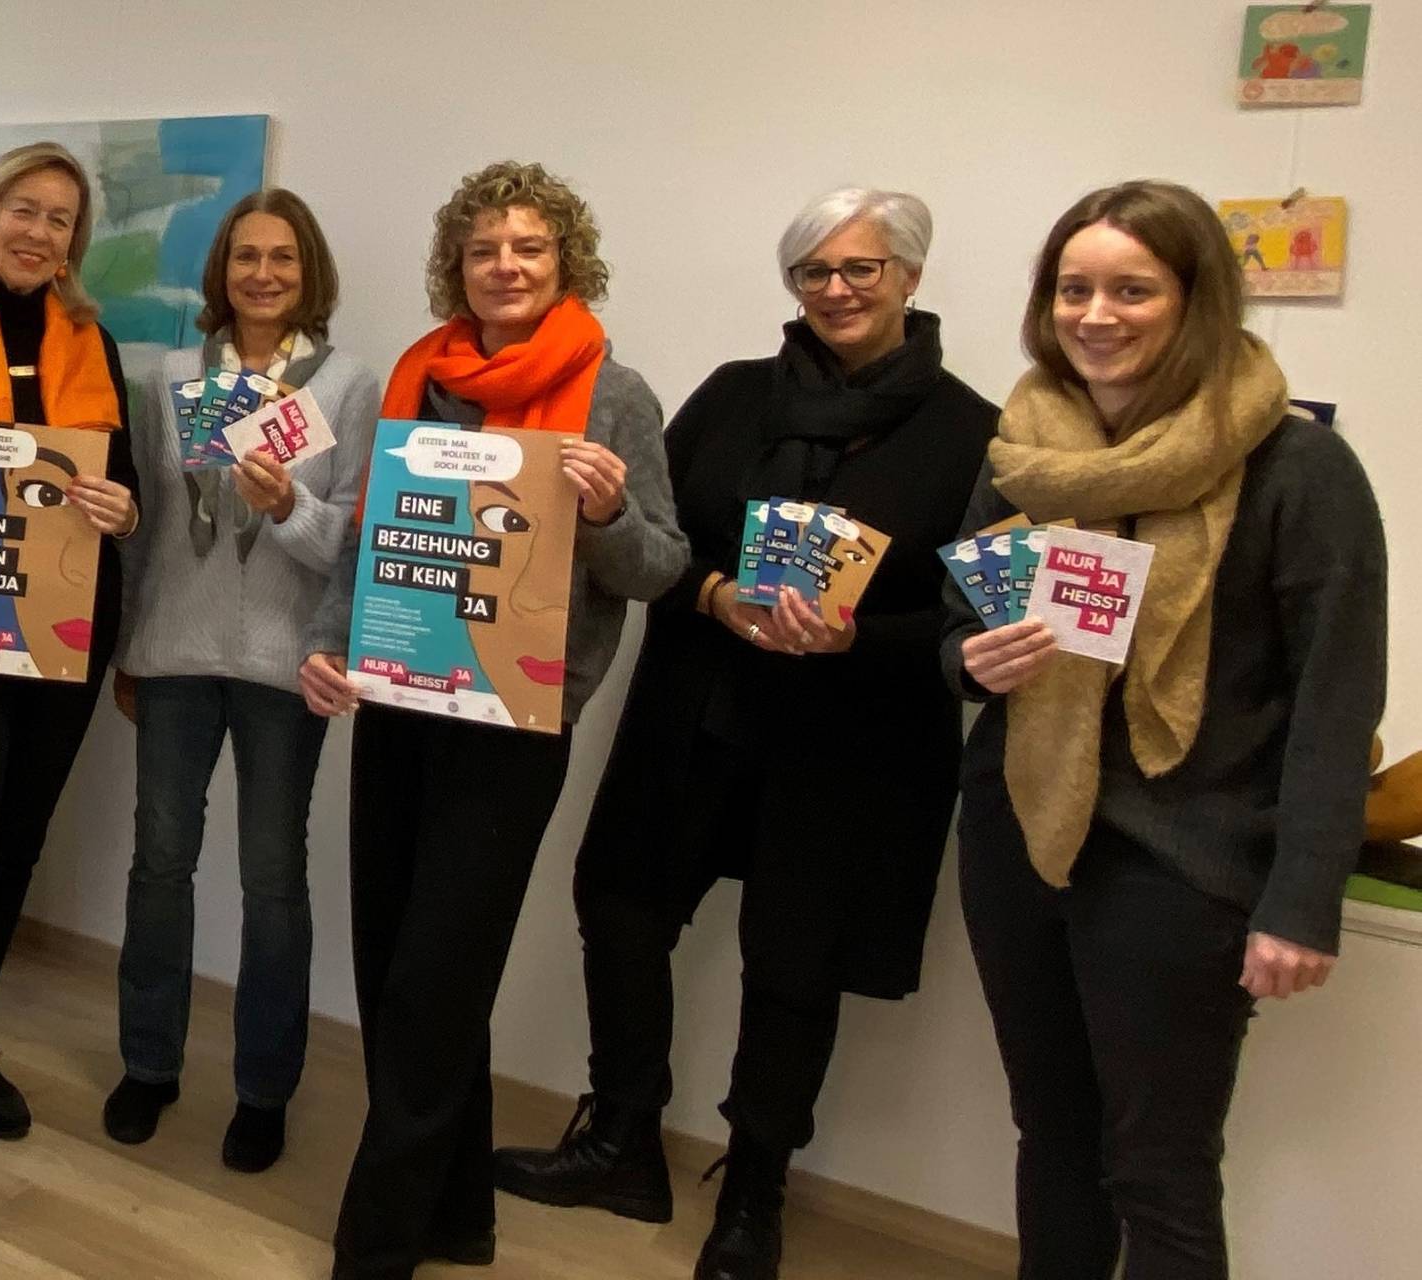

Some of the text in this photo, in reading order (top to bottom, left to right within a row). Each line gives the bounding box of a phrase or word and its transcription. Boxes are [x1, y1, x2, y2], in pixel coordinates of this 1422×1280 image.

[287, 405, 305, 429] NUR
[266, 424, 292, 459] HEISST
[291, 433, 304, 448] JA
[418, 437, 468, 448] LETZTES MAL
[441, 450, 497, 462] WOLLTEST DU
[434, 461, 487, 473] DOCH AUCH
[401, 496, 443, 516] EINE
[378, 529, 491, 559] BEZIEHUNG
[808, 534, 822, 545] EIN
[1057, 552, 1096, 571] NUR
[379, 561, 457, 588] IST KEIN
[1098, 572, 1120, 588] JA
[463, 597, 489, 617] JA
[1061, 586, 1125, 611] HEISST
[1088, 611, 1109, 629] JA
[1, 632, 13, 643] JA
[364, 658, 404, 675] NUR JA
[456, 668, 471, 682] JA
[408, 674, 449, 690] HEISST
